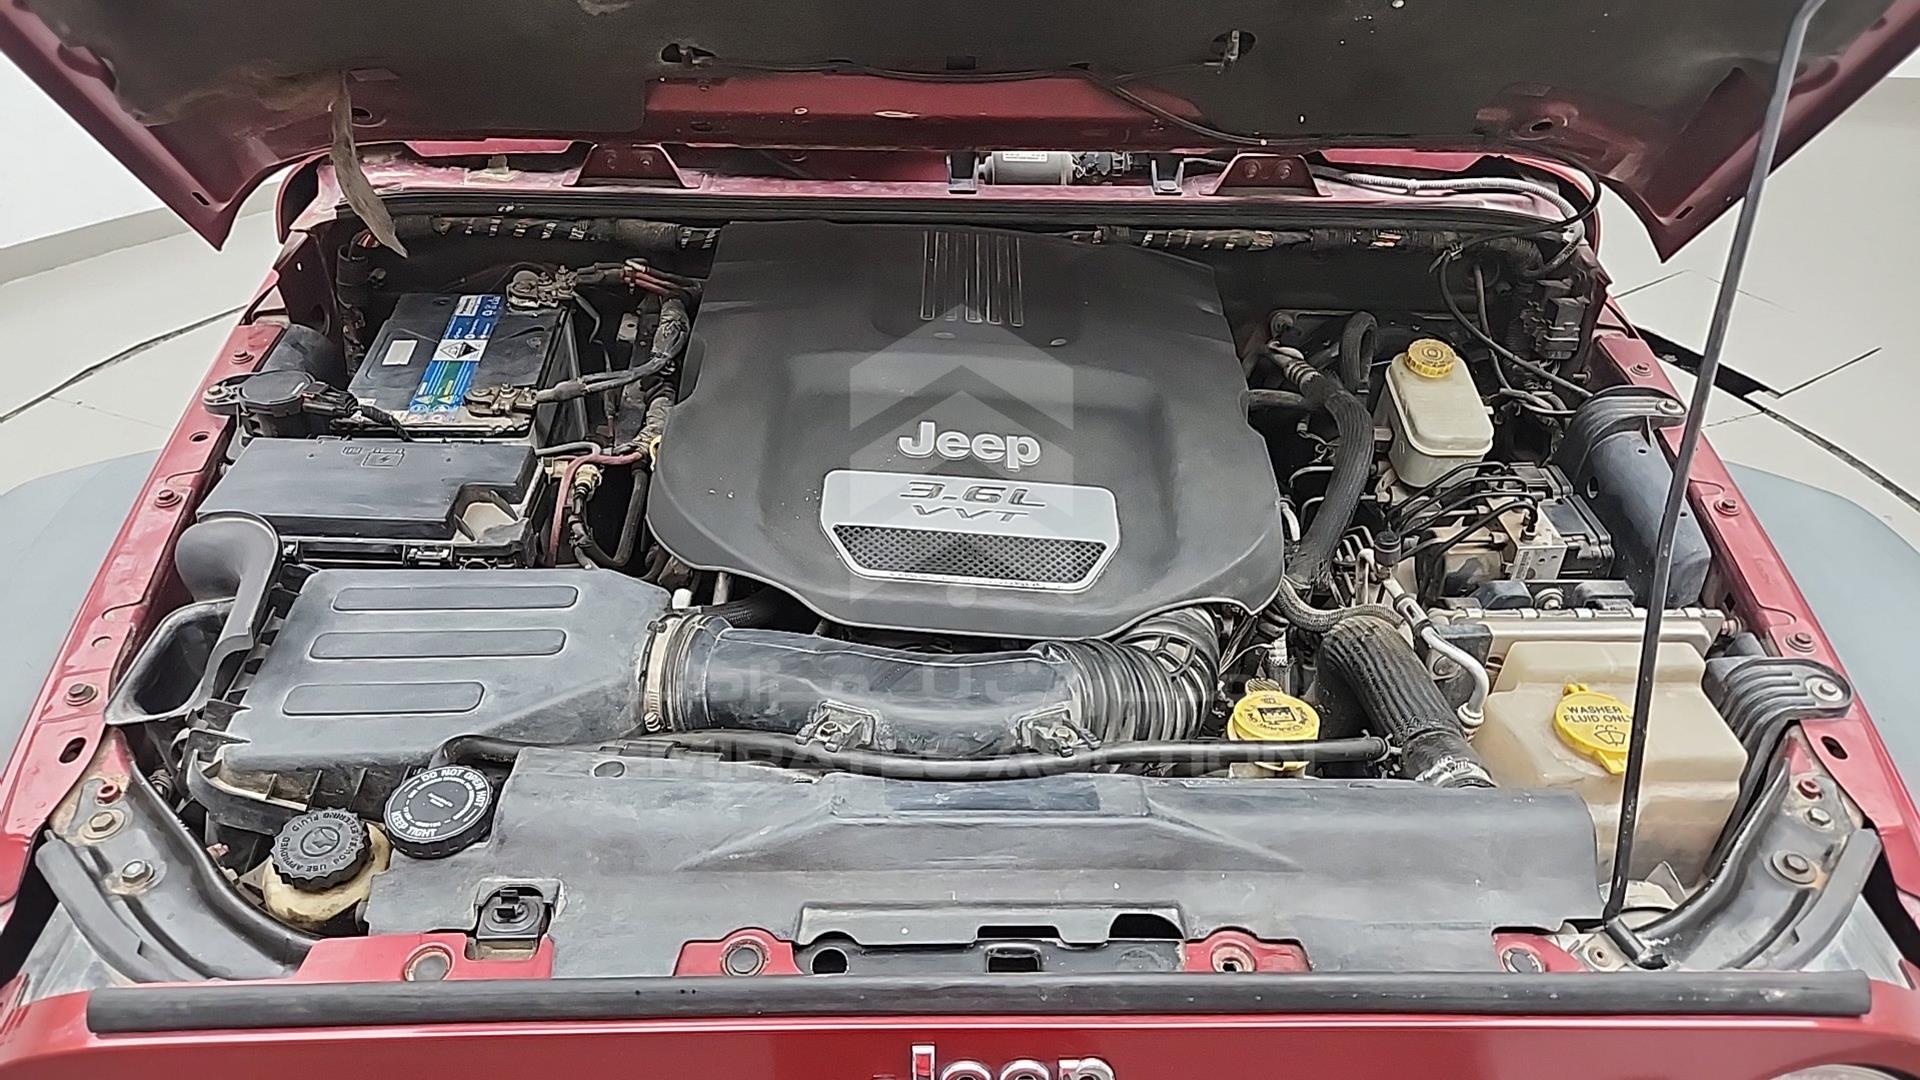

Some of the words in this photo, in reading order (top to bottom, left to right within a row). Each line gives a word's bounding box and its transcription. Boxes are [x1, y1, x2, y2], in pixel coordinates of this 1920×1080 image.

[898, 421, 1041, 470] Jeep
[899, 481, 1047, 507] 3.6L
[912, 504, 1030, 522] VVT
[1563, 714, 1600, 723] FLUID
[1566, 705, 1623, 714] WASHER
[420, 771, 438, 782] DO
[441, 768, 465, 777] NOT
[463, 771, 486, 791] OPEN
[474, 790, 487, 808] HOT
[291, 814, 319, 832] FLUID
[390, 810, 409, 830] KEEP
[406, 825, 438, 838] TIGHT
[305, 863, 328, 872] USE
